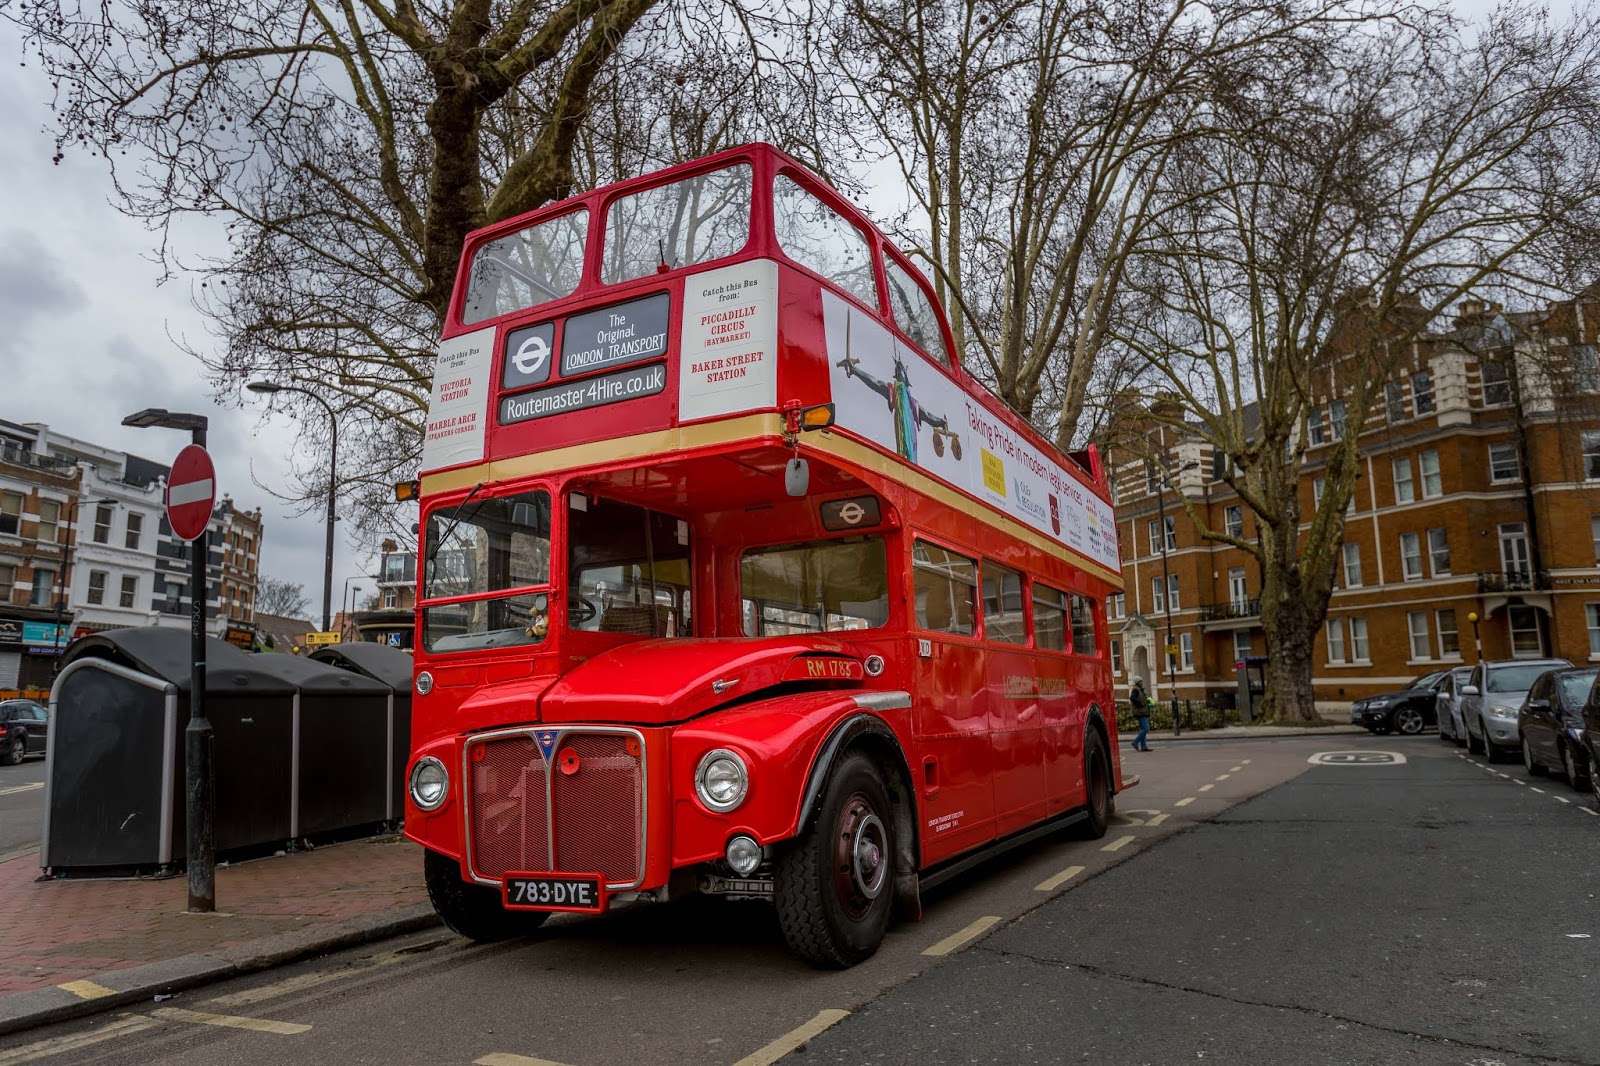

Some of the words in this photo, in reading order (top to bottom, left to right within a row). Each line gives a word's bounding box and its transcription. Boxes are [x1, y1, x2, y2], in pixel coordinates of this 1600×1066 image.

[702, 286, 724, 298] Catch
[726, 282, 741, 292] this
[743, 279, 758, 289] Bus
[719, 292, 740, 302] from:
[609, 314, 626, 328] The
[701, 306, 757, 326] PICCADILLY
[597, 324, 636, 344] Original
[711, 320, 745, 336] CIRCUS
[704, 331, 751, 348] (HAYMARKET)
[440, 354, 456, 364] Catch
[456, 351, 468, 360] this
[469, 348, 480, 356] Bus
[566, 348, 604, 370] LONDON
[608, 333, 666, 359] TRANSPORT
[691, 359, 724, 374] BAKER
[726, 351, 764, 368] STREET
[440, 377, 472, 392] VICTORIA
[707, 367, 747, 383] STATION
[440, 388, 469, 403] STATION
[428, 417, 457, 432] MARBLE
[457, 413, 477, 425] ARCH
[454, 424, 477, 436] CORNER)
[965, 401, 995, 450] Taking
[994, 425, 1015, 458] Pride
[1014, 440, 1022, 464] in
[1023, 452, 1048, 481] modern
[1062, 481, 1083, 506] services
[806, 658, 827, 677] RM
[829, 660, 852, 677] 1783
[1003, 675, 1033, 695] LONDON
[514, 881, 550, 903] 783
[553, 882, 592, 904] DYE
